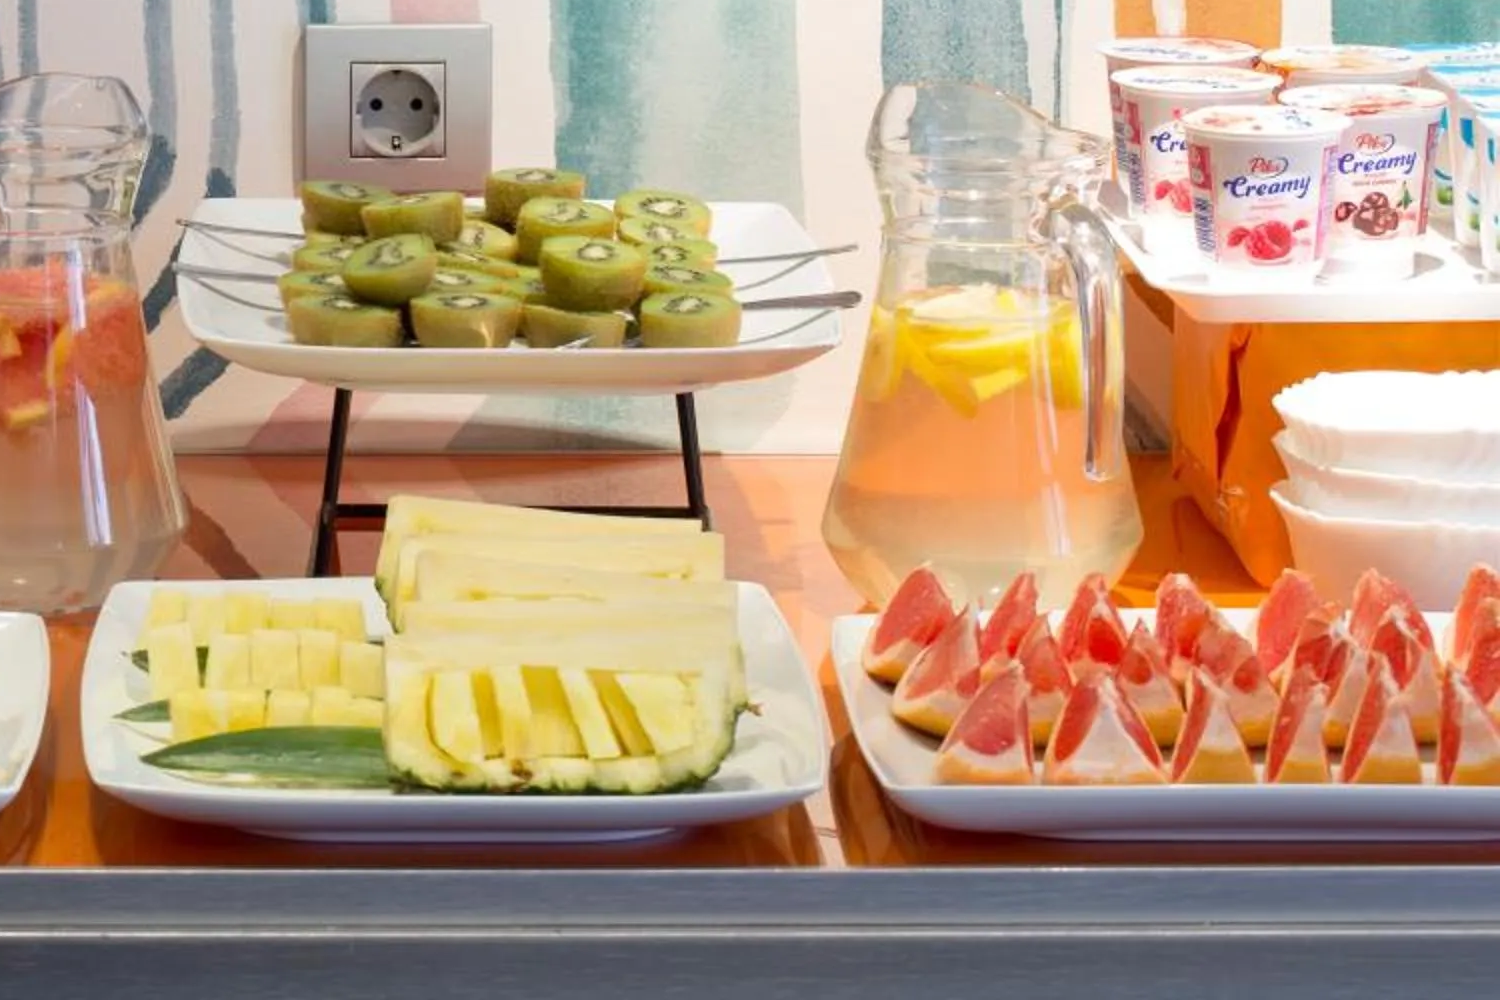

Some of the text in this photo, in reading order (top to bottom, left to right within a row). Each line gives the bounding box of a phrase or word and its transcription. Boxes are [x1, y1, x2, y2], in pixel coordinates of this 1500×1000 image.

[1150, 131, 1188, 153] Cre
[1337, 151, 1417, 175] Creamy
[1223, 175, 1311, 199] Creamy
